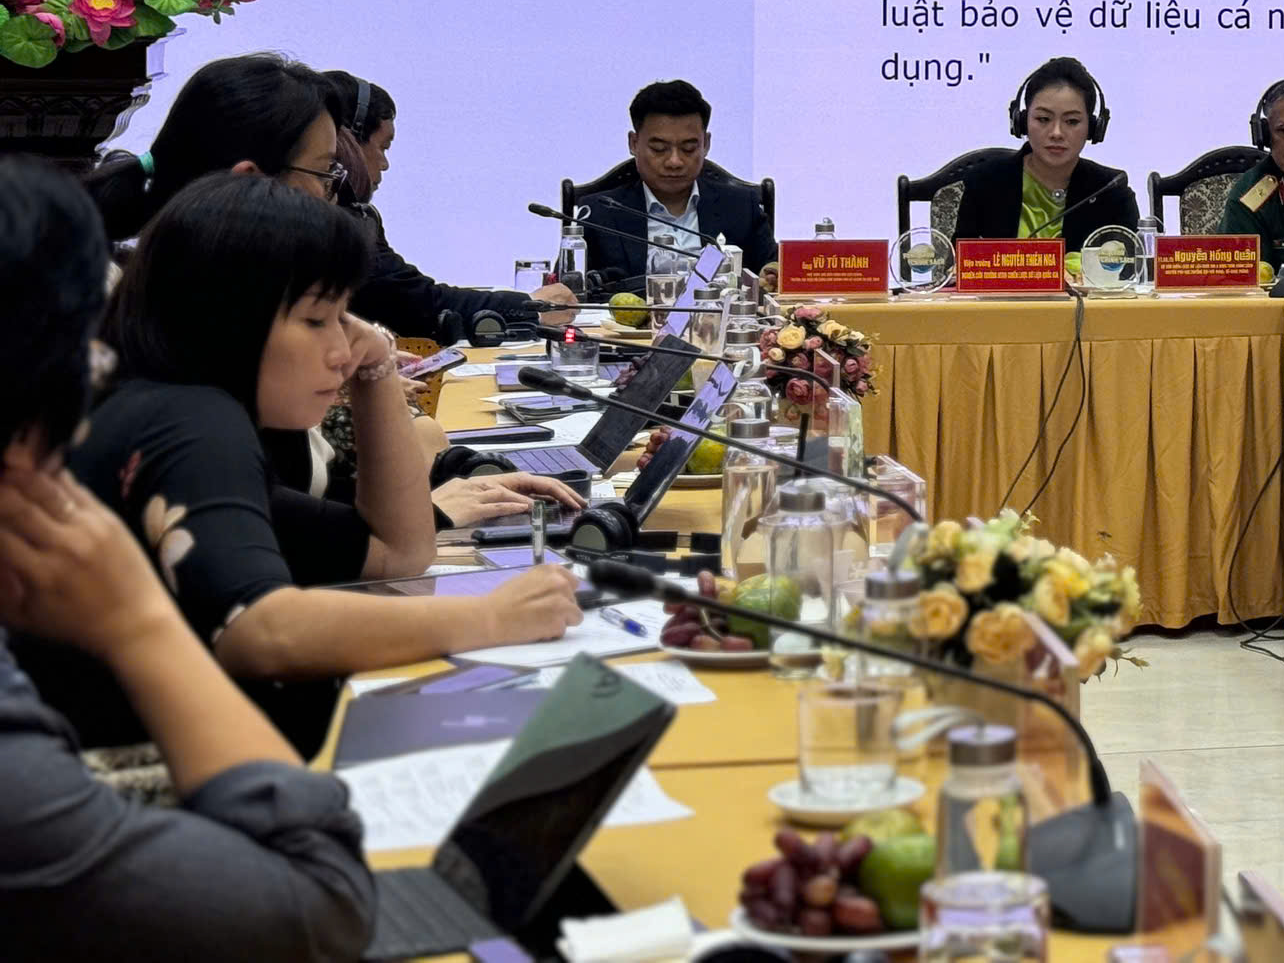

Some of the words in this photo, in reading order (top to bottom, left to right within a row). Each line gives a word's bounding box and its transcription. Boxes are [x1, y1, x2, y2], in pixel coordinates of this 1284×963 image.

[881, 52, 990, 87] dụng."
[813, 254, 825, 268] VŨ
[826, 254, 838, 269] TÚ
[840, 254, 869, 269] THÀNH
[1174, 247, 1208, 263] Nguyễn
[1234, 248, 1256, 261] Quân
